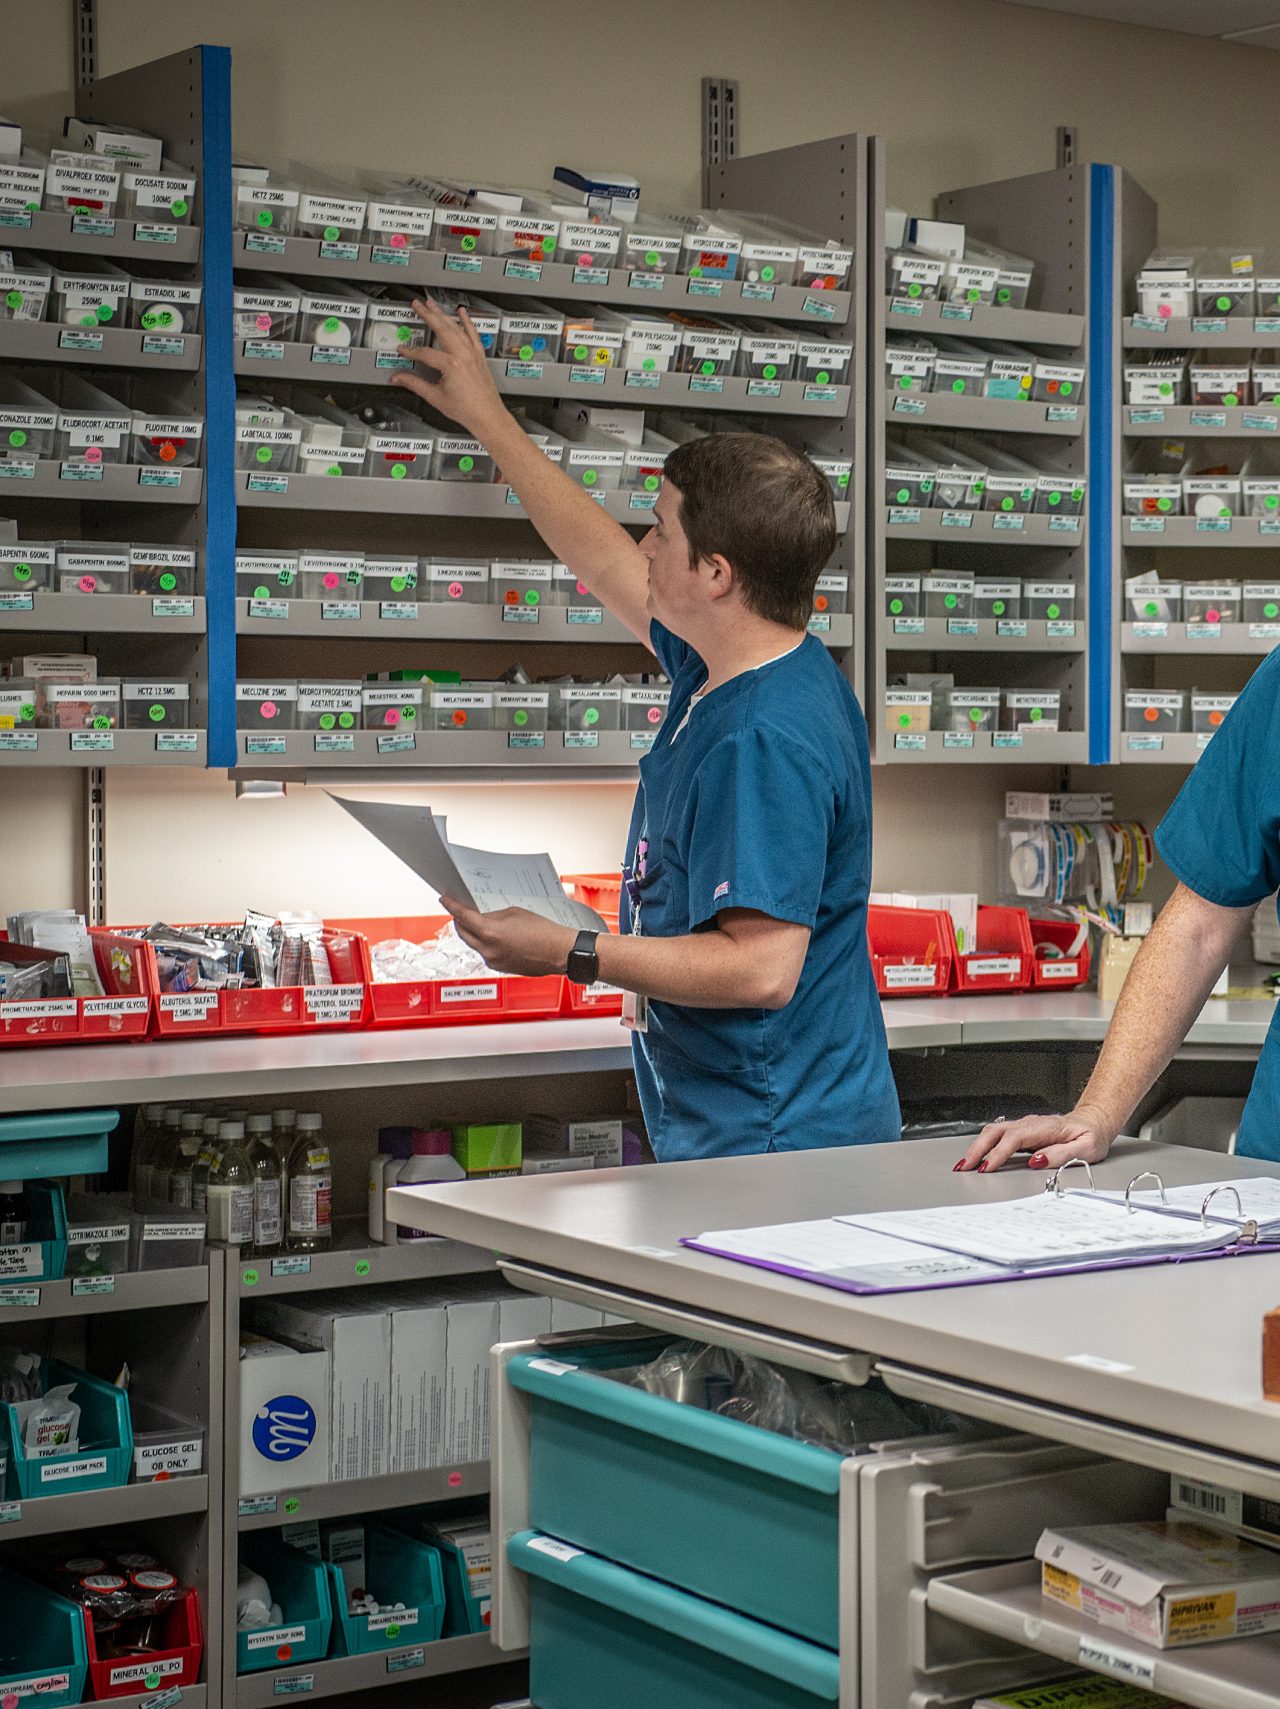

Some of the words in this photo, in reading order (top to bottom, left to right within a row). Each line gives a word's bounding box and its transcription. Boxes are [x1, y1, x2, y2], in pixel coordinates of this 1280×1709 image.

[56, 169, 92, 181] DIVALPROEX
[94, 174, 116, 184] SODIUM
[135, 178, 163, 189] DOCUSATE
[165, 182, 188, 191] SODIUM
[152, 195, 172, 203] 100MG
[252, 191, 266, 199] HCTZ
[268, 192, 284, 201] 25MG
[5, 198, 26, 206] DOSING
[309, 200, 362, 213] TRIAMTERENE/HCTZ
[378, 208, 430, 219] TRIAMTERENE/HCTZ
[343, 215, 357, 224] CAPS
[446, 213, 480, 224] HYDRALAZINE
[481, 216, 496, 226] 10MG
[411, 222, 425, 231] TABS
[506, 220, 540, 230] HYDRALAZINE
[541, 224, 555, 232] 25MG
[570, 239, 592, 248] SULFATE
[594, 241, 611, 250] 200MG
[664, 240, 681, 250] 500MG
[726, 240, 738, 250] 25MG
[63, 282, 109, 292] ERYTHROMYCIN
[110, 284, 126, 293] BASE
[145, 288, 176, 298] ESTRADIOL
[178, 290, 190, 299] 1MG
[82, 296, 102, 305] 250MG
[243, 297, 275, 306] IMIPRAMINE
[277, 299, 292, 308] 25MG
[310, 302, 342, 313] INDAPAMIDE
[343, 305, 361, 315] 2.5MG
[509, 319, 540, 330] IRBESARTAN
[541, 322, 558, 331] 150MG
[32, 416, 53, 425] 200MG
[63, 419, 129, 430] FLUDROCORT/ACETATE
[145, 424, 180, 433] FLUOXETINE
[182, 426, 197, 434] 10MG
[85, 435, 104, 443] 0.1MG
[242, 431, 273, 439] LABETALOL
[274, 432, 293, 440] 100MG
[377, 439, 412, 449] LAMOTRIGINE
[414, 441, 430, 450] 100MG
[440, 441, 479, 451] LEVOFLOXACIN
[29, 551, 49, 560] 600MG
[133, 552, 170, 562] GEMFIBROZIL
[437, 569, 464, 577] LINEZOLID
[56, 689, 81, 697] HEPARIN
[138, 687, 153, 695] HCTZ
[154, 687, 175, 696] 12.5MG
[242, 688, 269, 696] MECLIZINE
[271, 688, 287, 696] 25MG
[369, 692, 398, 701] MEGESTROL
[631, 691, 662, 701] METAXALONE
[311, 700, 334, 708] ACETATE
[336, 700, 352, 708] 2.5MG
[443, 696, 472, 704] MELATONIN
[444, 990, 461, 998] SALINE
[477, 988, 493, 996] FLUSH
[126, 1000, 147, 1009] GLYCOL
[160, 998, 191, 1007] ALBUTEROL
[193, 995, 217, 1005] SULFATE
[307, 1001, 335, 1009] ALBUTEROL
[337, 1000, 360, 1008] SULFATE
[2, 1005, 46, 1014] PROMETHAZINE
[69, 1229, 108, 1240] LOTRIMAZOLE
[110, 1228, 126, 1237] 10MG
[37, 1422, 69, 1433] glucose
[36, 1434, 51, 1445] gel
[142, 1447, 178, 1457] GLUCOSE
[181, 1444, 197, 1453] GEL
[44, 1466, 70, 1476] GLUCOSE
[72, 1464, 86, 1474] 15GM
[88, 1461, 104, 1471] PACK
[152, 1461, 164, 1471] OB
[167, 1459, 188, 1469] ONLY
[1170, 1600, 1217, 1618] DIPRIVAN
[368, 1616, 405, 1627] ONDANSETRON
[406, 1614, 416, 1622] HCL
[248, 1634, 274, 1644] NYSTATIN
[275, 1632, 289, 1640] SUSP
[290, 1630, 305, 1638] 60ML
[113, 1668, 149, 1681] MINERAL
[152, 1664, 166, 1674] OIL
[169, 1662, 181, 1671] PO
